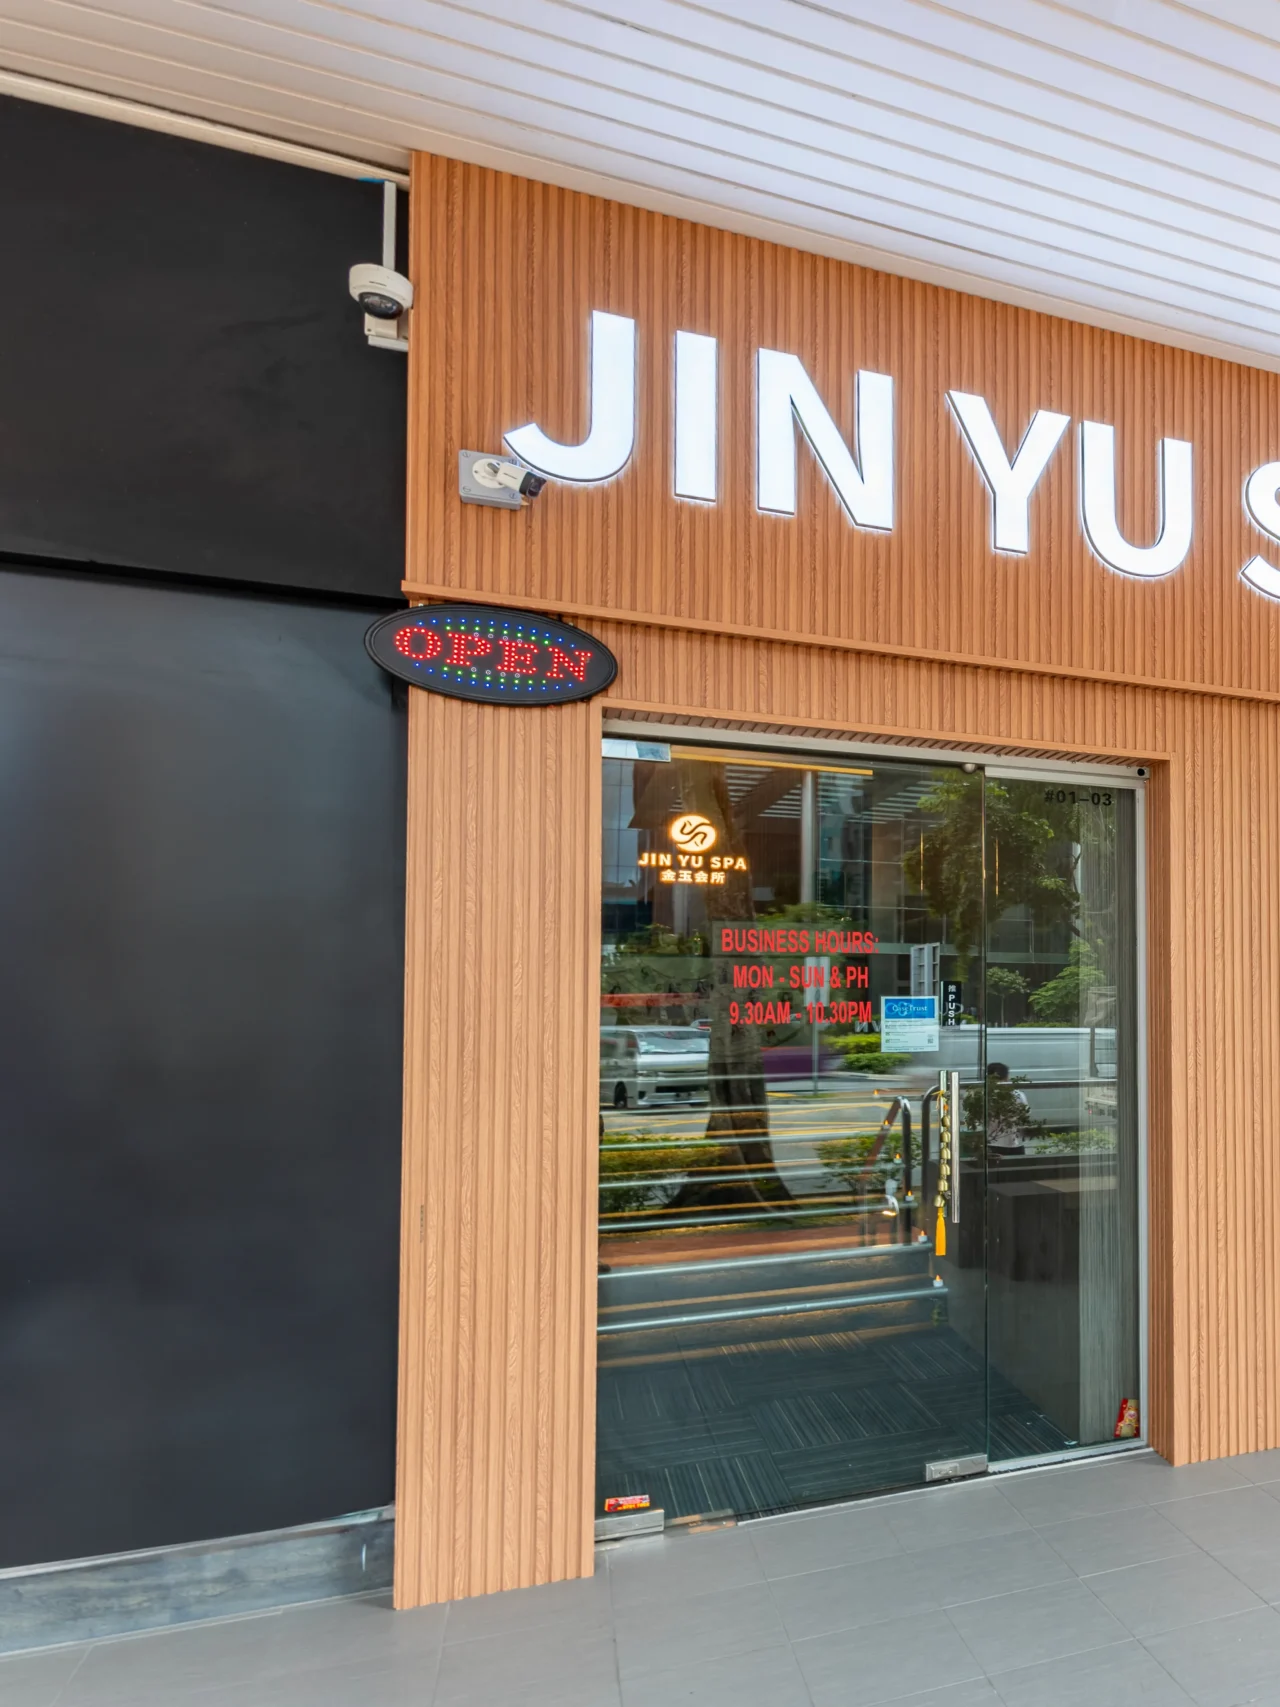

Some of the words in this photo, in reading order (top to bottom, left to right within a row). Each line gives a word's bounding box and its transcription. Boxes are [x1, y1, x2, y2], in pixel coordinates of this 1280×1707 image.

[503, 309, 893, 533] JIN
[945, 389, 1193, 579] YU
[394, 625, 594, 683] OPEN
[638, 852, 672, 867] JIN
[677, 854, 704, 868] YU
[710, 856, 747, 870] SPA
[660, 869, 726, 884] 金玉会所
[721, 928, 810, 953] BUSINESS
[815, 930, 879, 954] HOURS:
[733, 965, 774, 989] MON
[789, 965, 824, 988] SUN
[830, 965, 841, 989] &
[846, 965, 869, 988] PH
[729, 1001, 791, 1025] 9.30AM
[806, 1001, 872, 1024] 10.30PM
[948, 994, 956, 1026] PUSH
